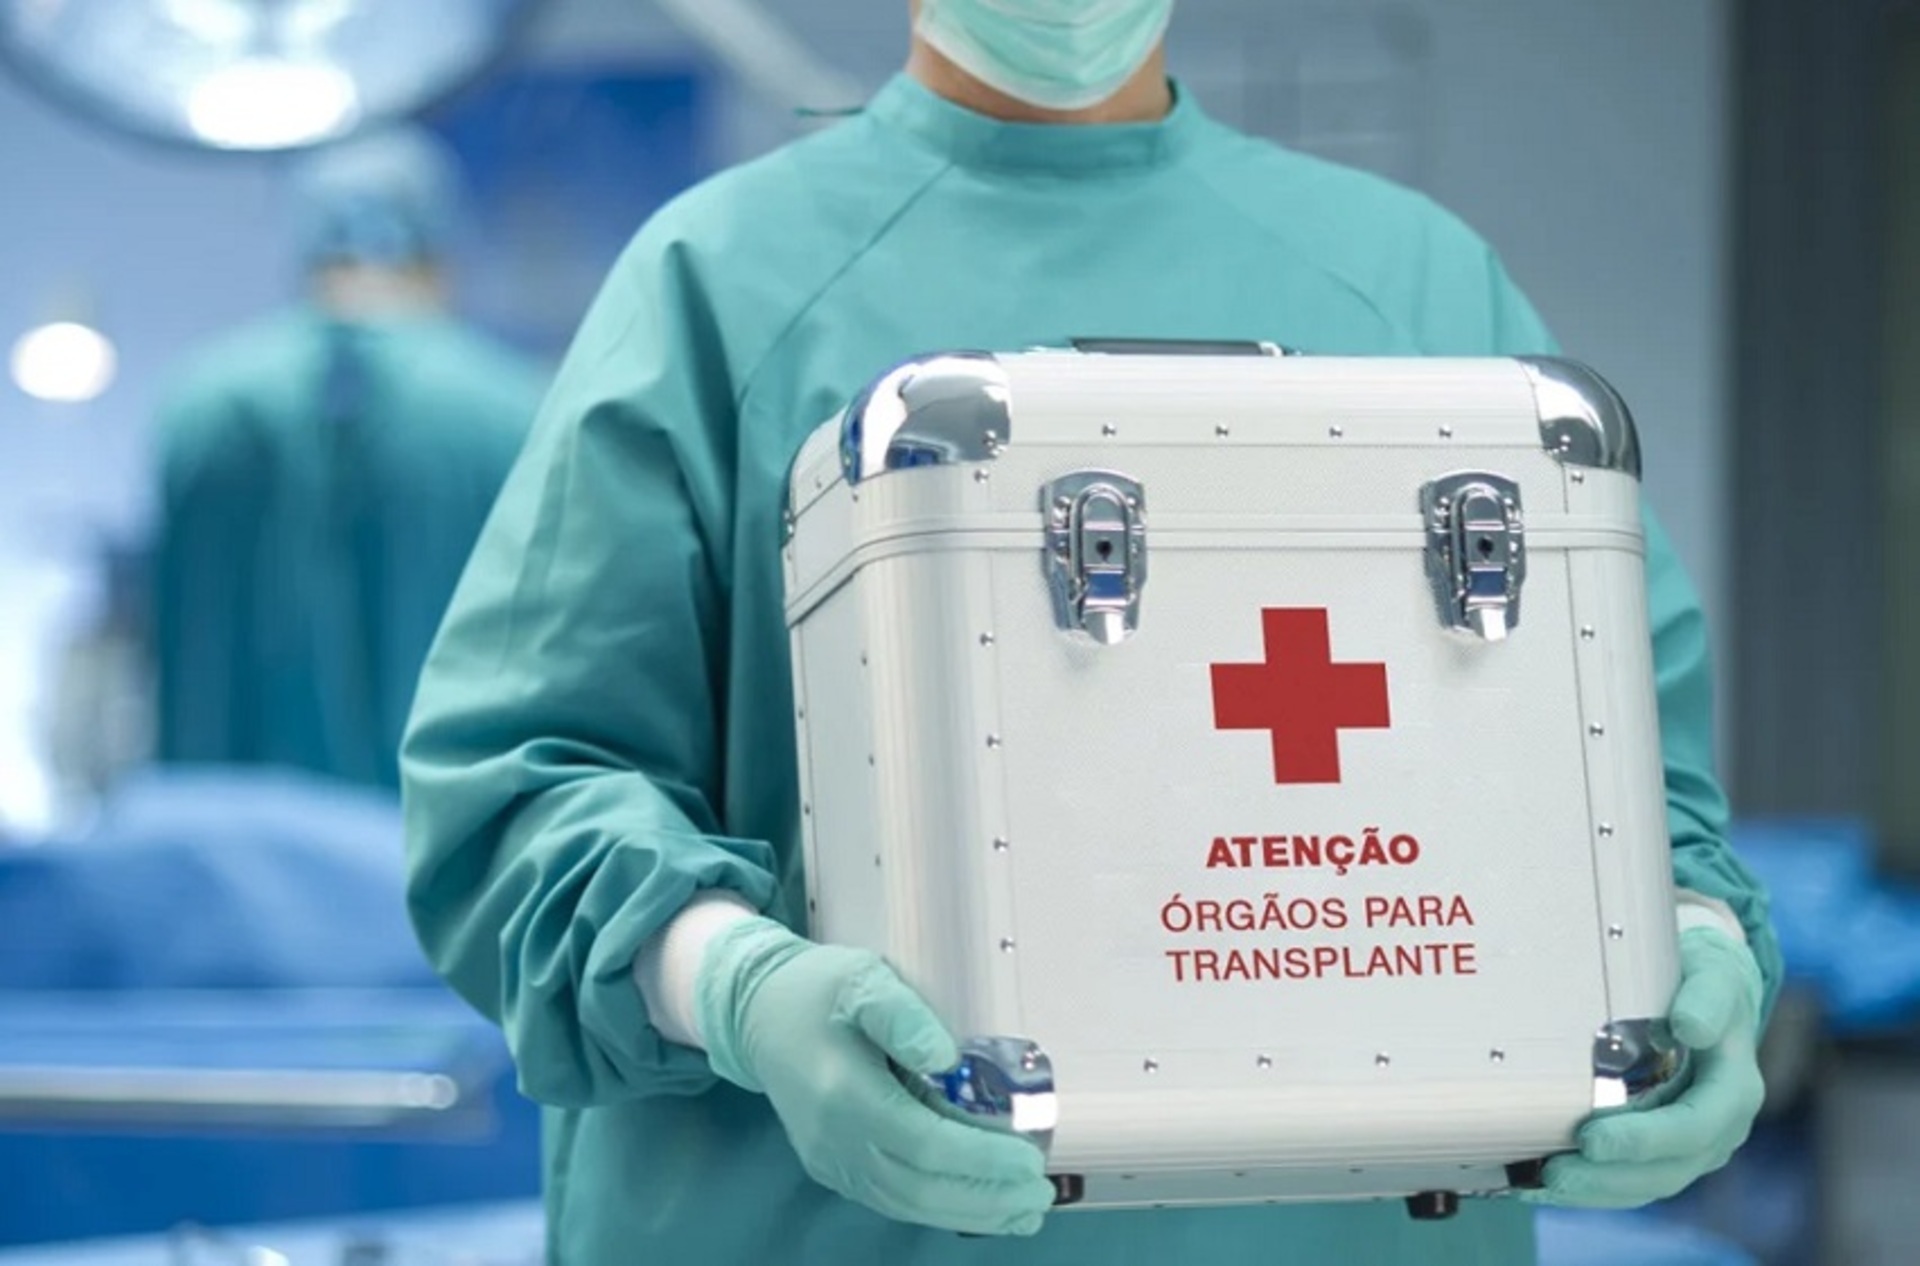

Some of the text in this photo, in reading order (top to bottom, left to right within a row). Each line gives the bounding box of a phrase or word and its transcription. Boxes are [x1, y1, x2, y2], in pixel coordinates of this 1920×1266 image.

[1206, 827, 1421, 875] ATENÇÃO
[1160, 893, 1474, 933] ÓRGÃOS PARA
[1166, 942, 1477, 982] TRANSPLANTE
